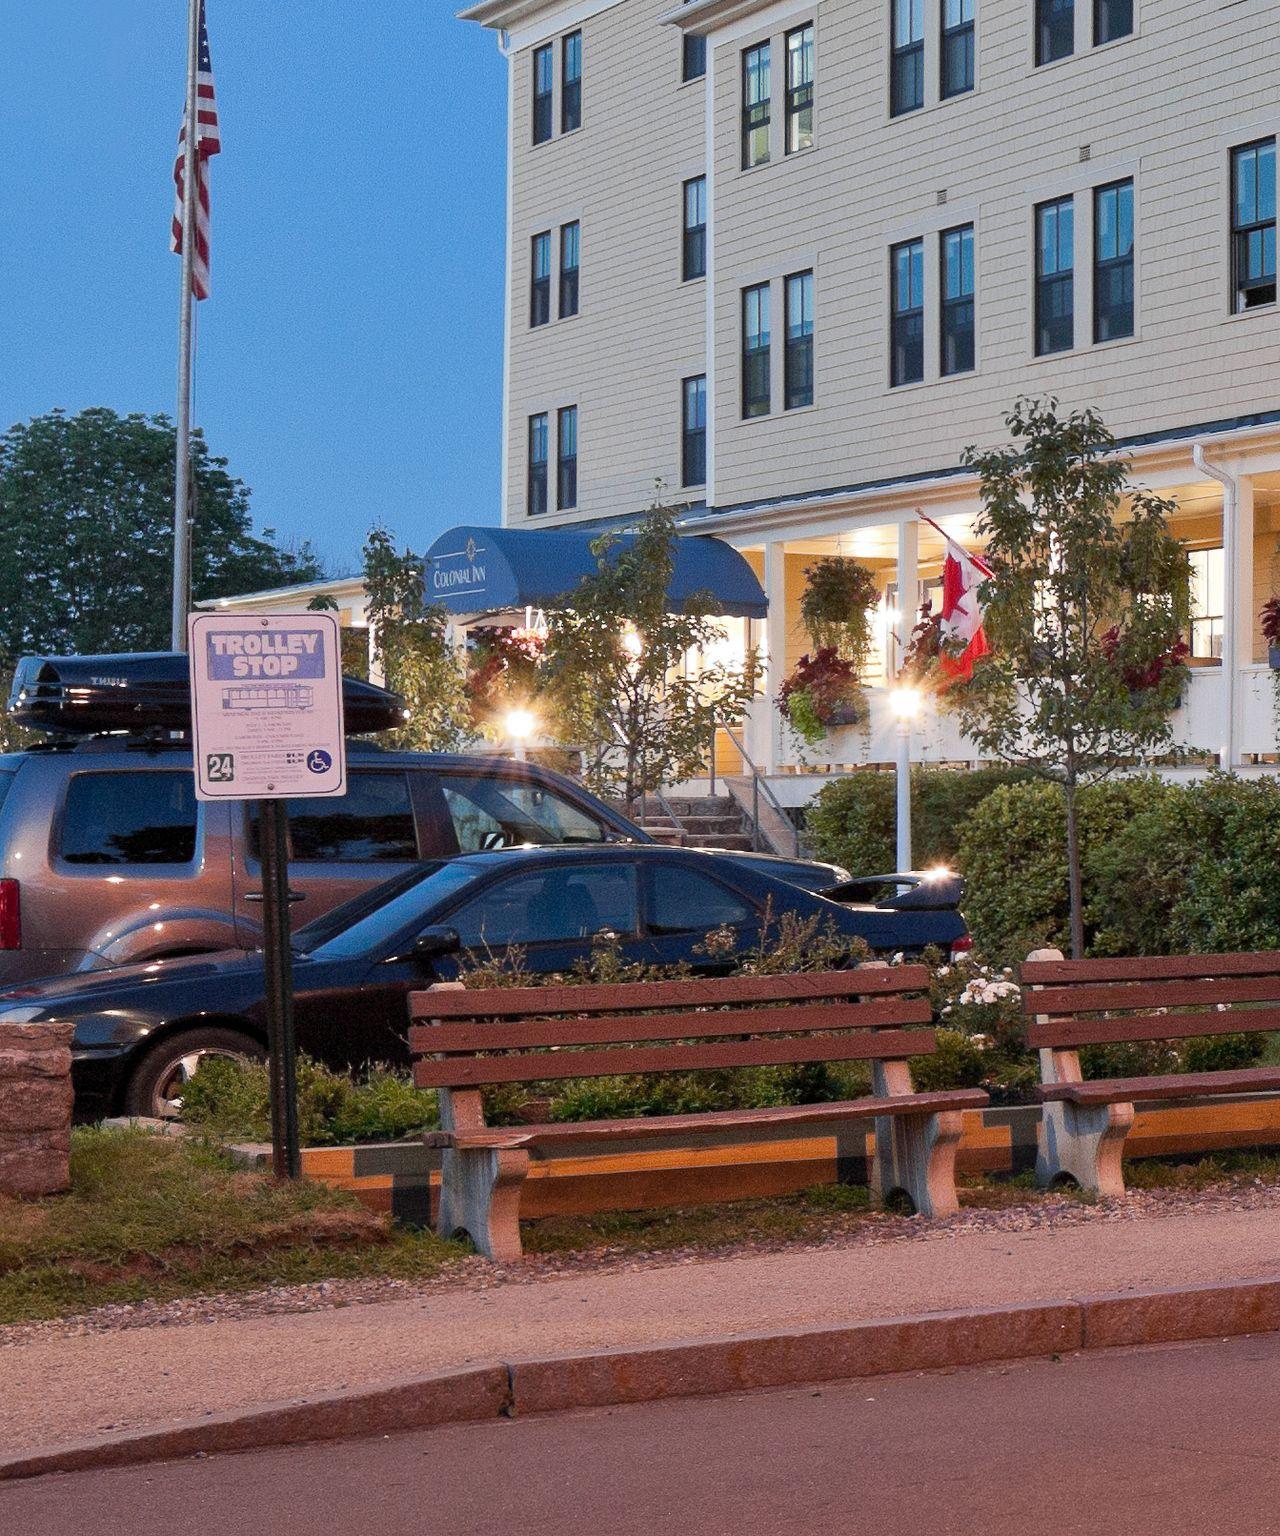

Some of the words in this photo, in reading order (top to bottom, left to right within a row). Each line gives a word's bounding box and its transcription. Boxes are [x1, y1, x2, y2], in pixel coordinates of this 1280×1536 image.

[433, 569, 471, 589] COLONIAL
[472, 565, 486, 582] INN
[211, 633, 319, 656] TROLLEY
[232, 655, 298, 677] STOP
[208, 756, 233, 779] 24
